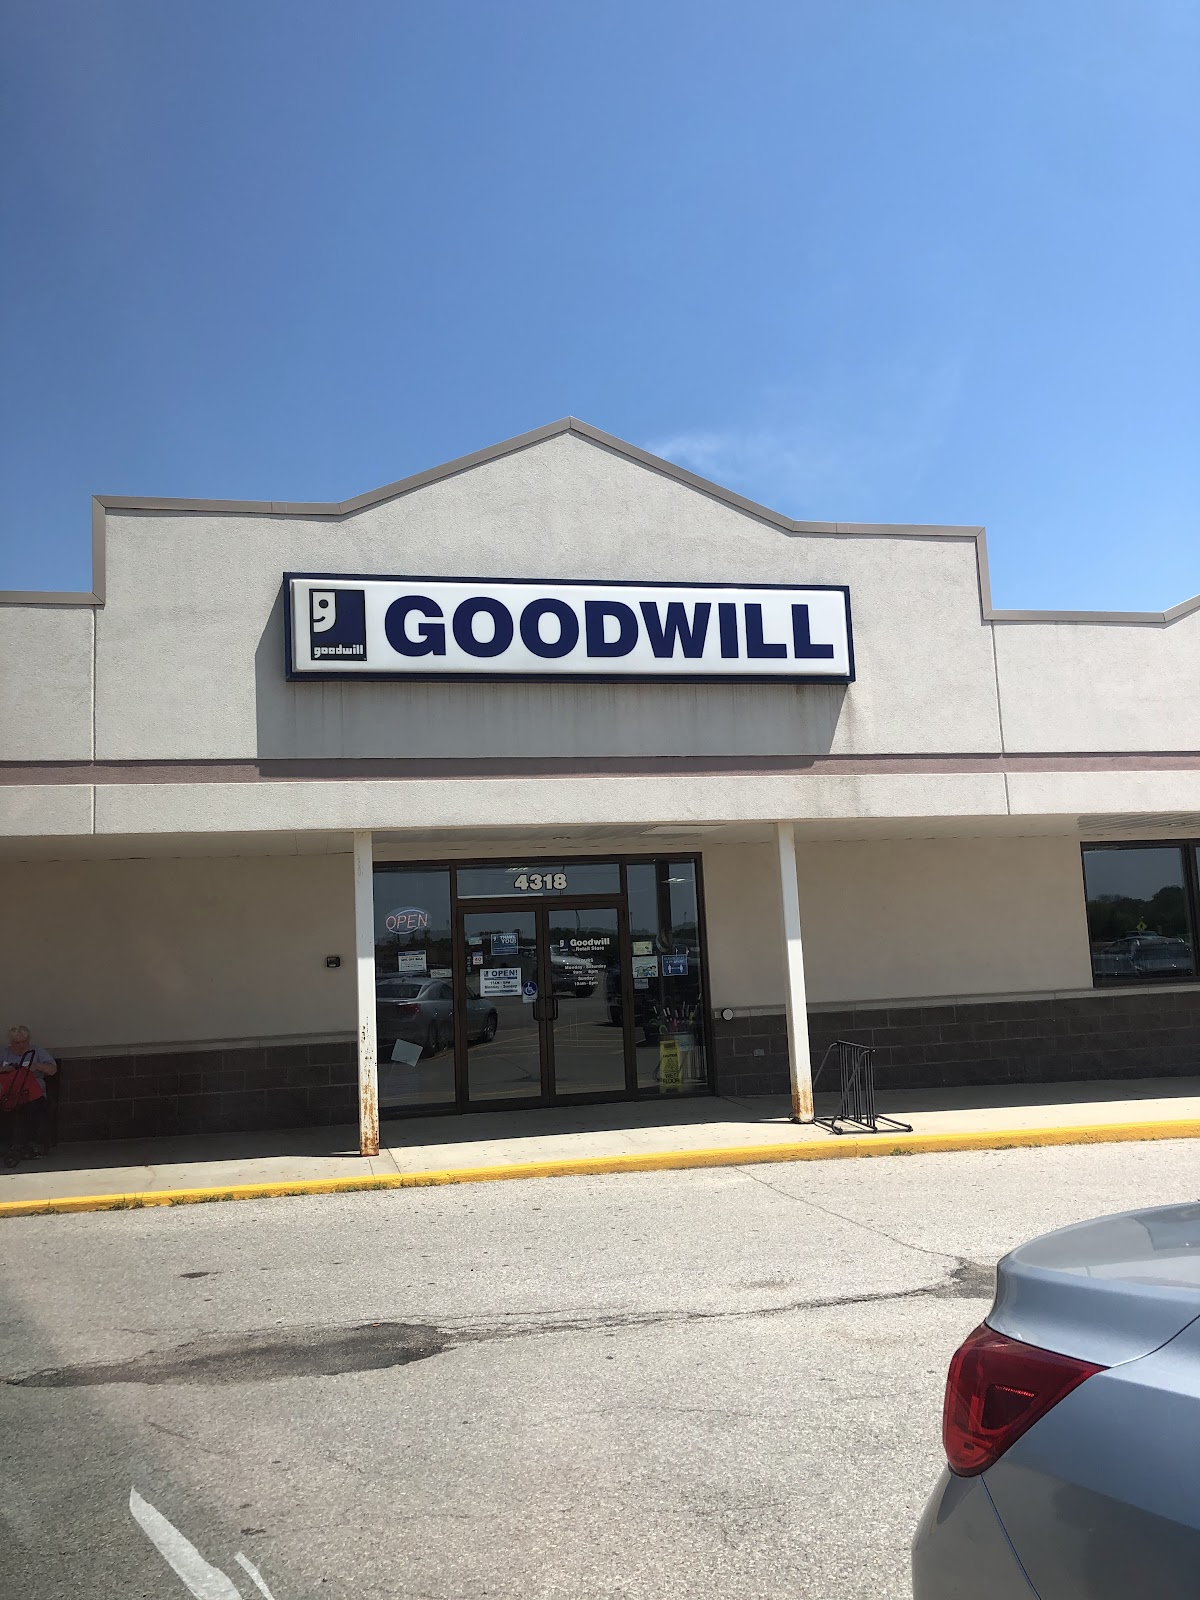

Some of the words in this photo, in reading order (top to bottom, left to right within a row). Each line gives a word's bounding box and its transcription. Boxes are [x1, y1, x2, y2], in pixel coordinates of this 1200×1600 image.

[384, 595, 834, 659] GOODWILL
[313, 643, 364, 659] goodwill
[514, 873, 568, 891] 4318
[385, 913, 428, 930] OPEN
[570, 937, 610, 947] Goodwill
[491, 969, 518, 977] OPEN!
